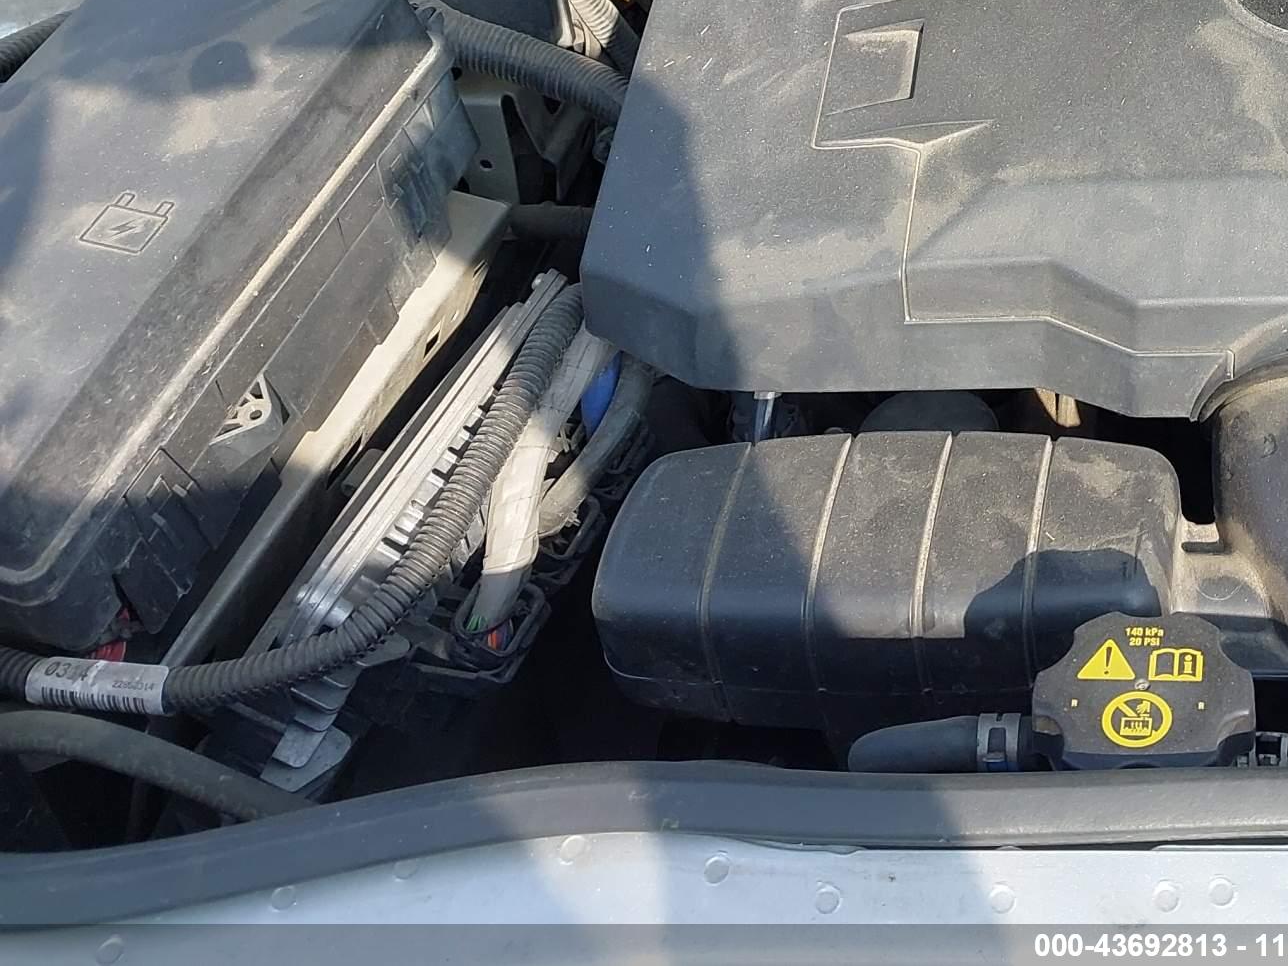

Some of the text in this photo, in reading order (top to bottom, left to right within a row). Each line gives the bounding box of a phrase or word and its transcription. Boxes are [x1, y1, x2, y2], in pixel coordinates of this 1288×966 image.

[1125, 627, 1164, 636] 140 kPa
[1129, 637, 1160, 646] 20 PSI
